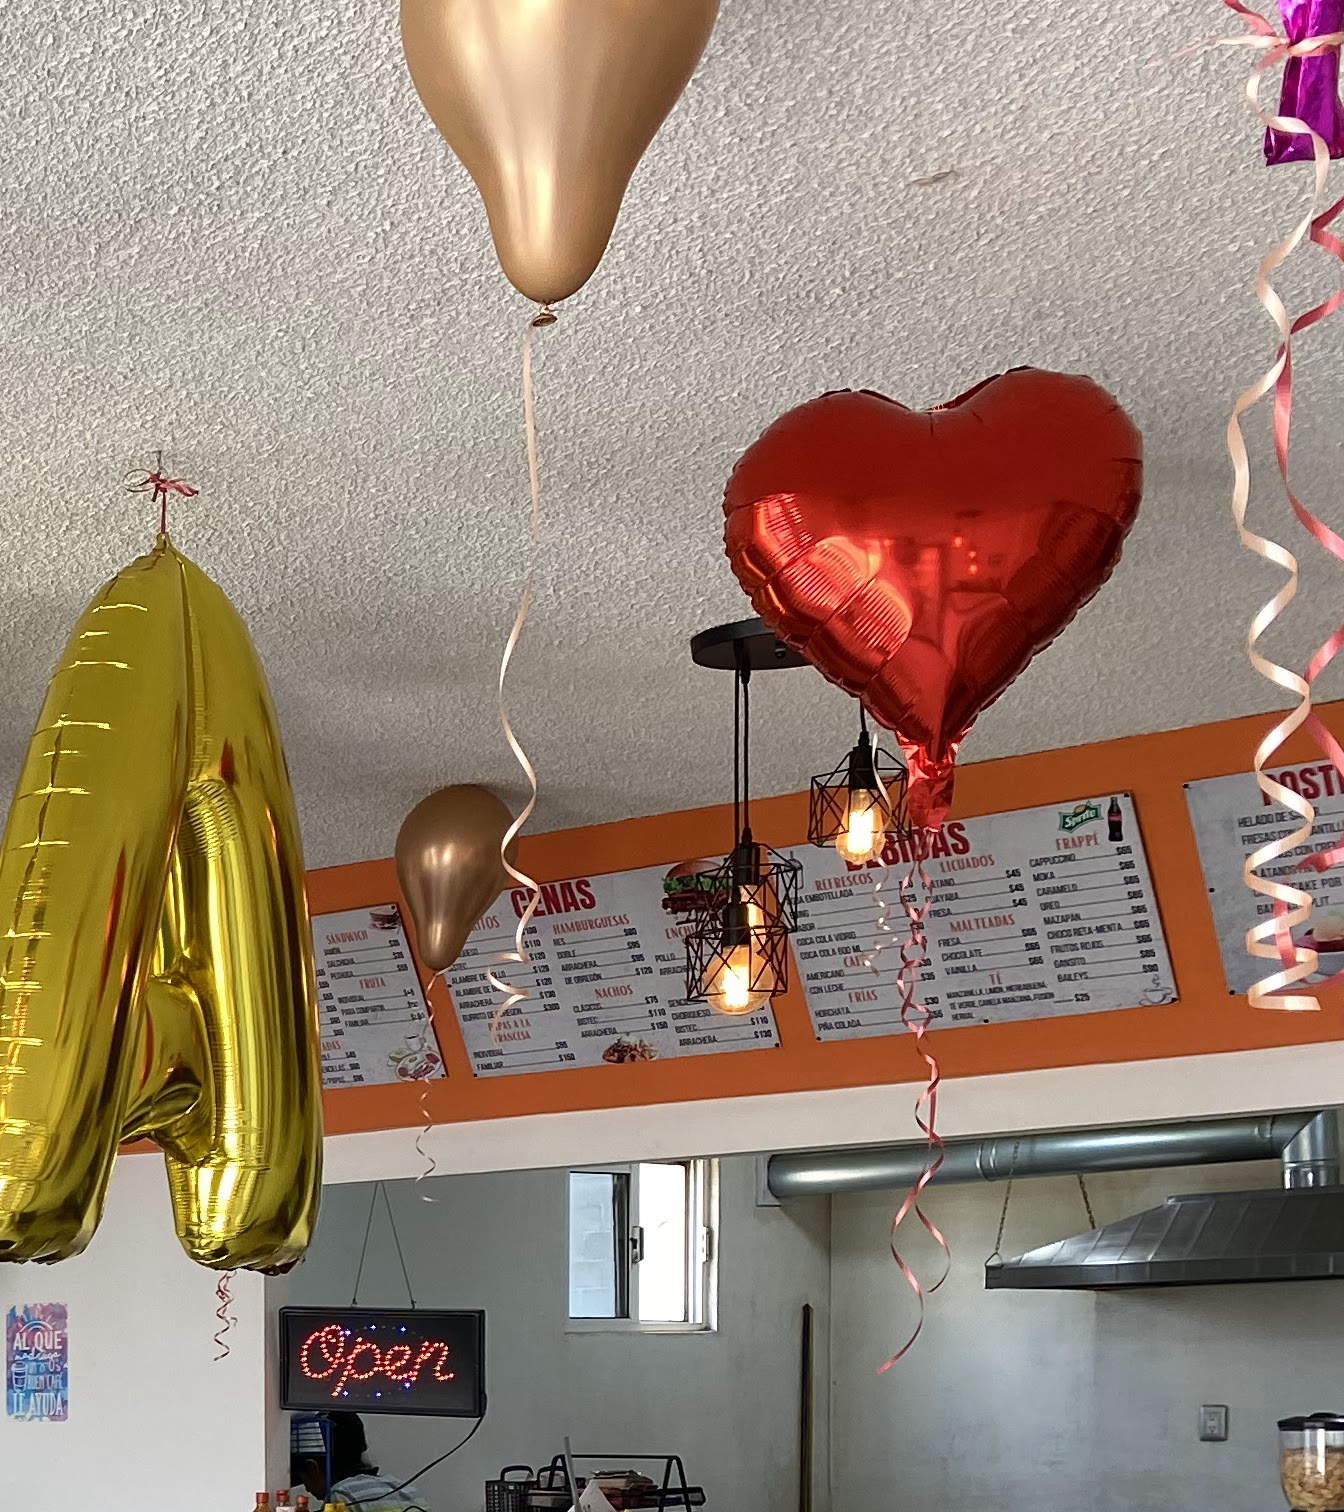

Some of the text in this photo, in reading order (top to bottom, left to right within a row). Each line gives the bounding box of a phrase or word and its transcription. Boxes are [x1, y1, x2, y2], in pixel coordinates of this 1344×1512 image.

[1065, 809, 1097, 829] Sprite
[846, 822, 971, 871] BIDAS
[940, 854, 995, 873] LICUADOS
[511, 879, 596, 919] CENAS
[553, 914, 629, 935] HAMBURGUESAS
[949, 913, 1015, 933] MALTEADAS
[595, 984, 633, 999] NACHOS
[13, 1330, 63, 1354] AL QUE
[299, 1324, 455, 1398] Open
[29, 1393, 63, 1416] AYUDA
